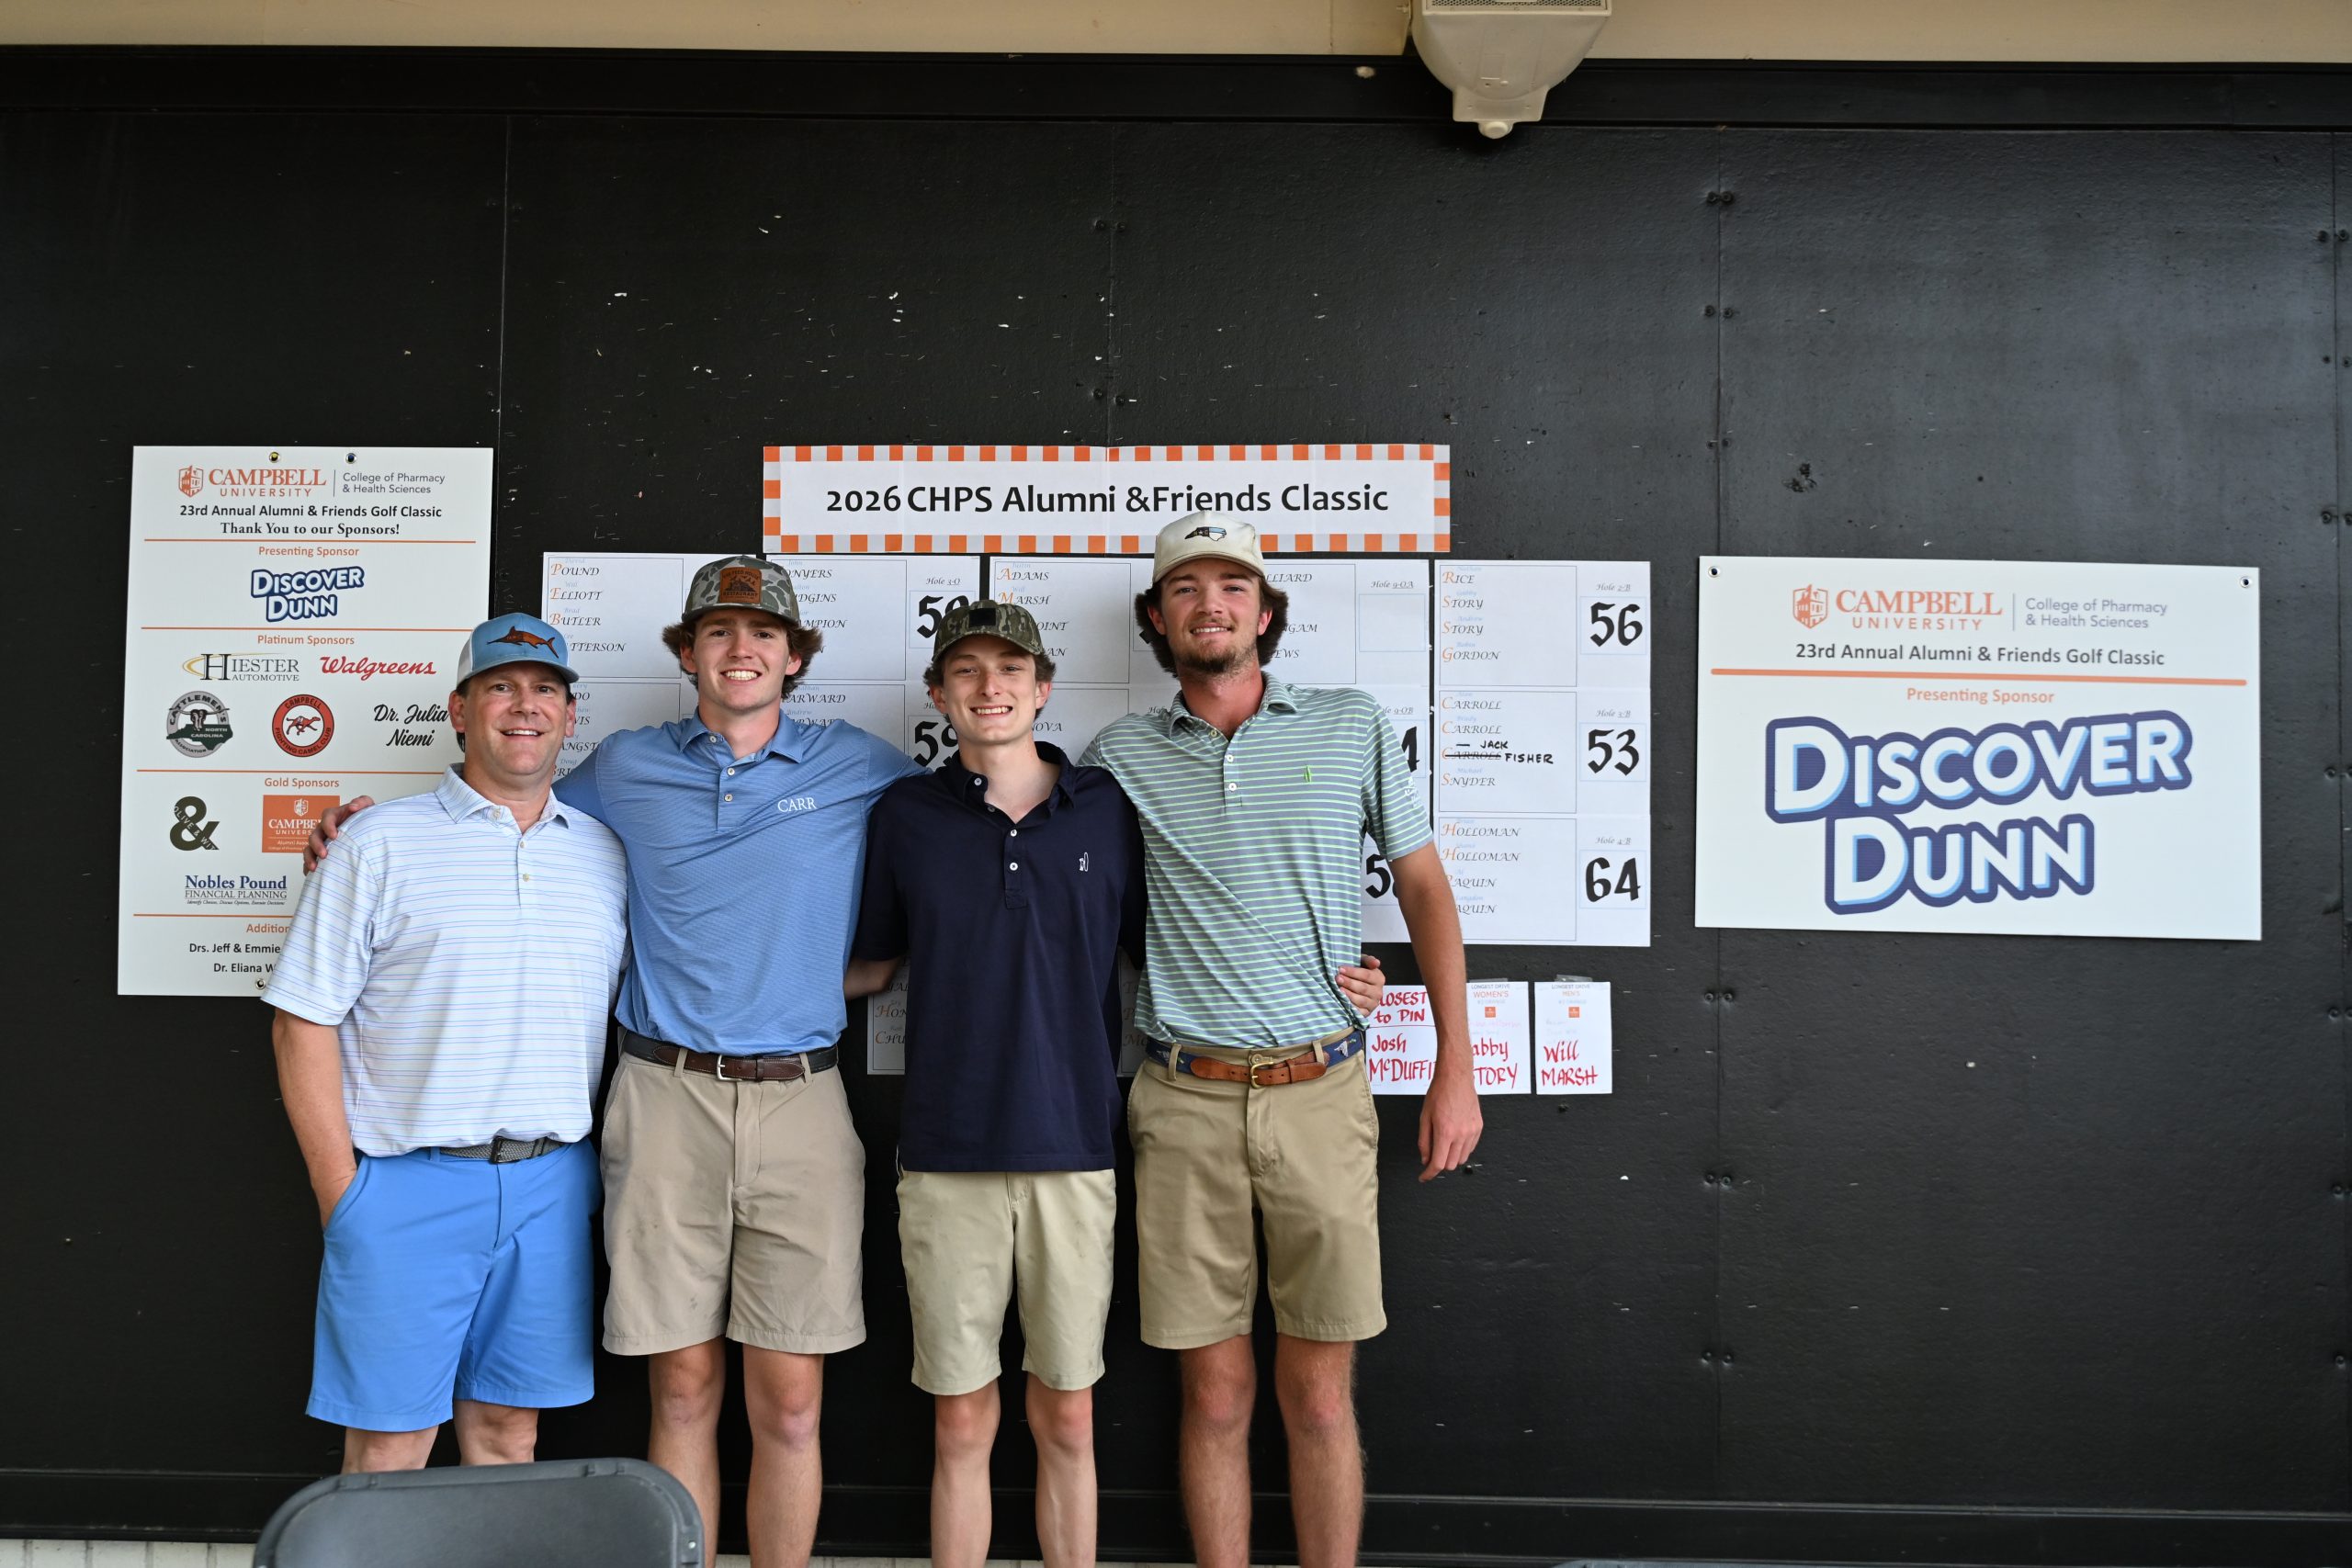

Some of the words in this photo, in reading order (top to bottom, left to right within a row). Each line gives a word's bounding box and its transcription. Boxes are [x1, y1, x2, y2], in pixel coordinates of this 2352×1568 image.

[209, 468, 327, 487] CAMPBELL
[343, 472, 381, 483] College
[384, 472, 395, 482] of
[397, 473, 446, 485] Pharmacy
[220, 488, 312, 497] UNIVERSITY
[343, 484, 352, 494] &
[354, 484, 394, 493] Health
[396, 484, 432, 494] Sciences
[827, 484, 901, 512] 2026
[907, 486, 992, 513] CHPS
[1001, 484, 1115, 513] Alumni
[1281, 483, 1388, 512] Classic
[179, 504, 209, 516] 23rd
[211, 505, 255, 516] Annual
[259, 505, 304, 517] Alumni
[308, 505, 318, 517] &
[322, 505, 368, 517] Friends
[370, 505, 398, 517] Golf
[401, 506, 442, 517] Classic
[220, 522, 262, 535] Thank
[266, 523, 290, 535] You
[294, 525, 307, 535] to
[311, 525, 334, 535] our
[337, 524, 401, 538] Sponsors!
[258, 546, 314, 557] Presenting
[316, 547, 360, 558] Sponsor
[550, 563, 600, 576] POUND
[786, 569, 832, 579] ONYERS
[997, 567, 1050, 581] ADAMS
[252, 567, 365, 597] DISCOVER
[926, 577, 945, 586] Hole
[1266, 573, 1313, 582] LLIARD
[1442, 571, 1476, 584] RICE
[1370, 581, 1391, 589] Hole
[1596, 582, 1615, 591] Hole
[549, 587, 605, 600] ELLIOTT
[795, 594, 837, 604] DGINS
[997, 592, 1052, 604] MARSH
[267, 594, 337, 621] DUNN
[1442, 595, 1484, 610] STORY
[1836, 589, 2003, 615] CAMPBELL
[2025, 597, 2078, 614] College
[2083, 598, 2098, 612] of
[2101, 599, 2168, 616] Pharmacy
[549, 613, 602, 626] BUTLER
[1589, 601, 1643, 647] 56
[1852, 616, 1983, 631] UNIVERSITY
[2025, 614, 2037, 626] &
[2041, 614, 2086, 626] Health
[2090, 615, 2149, 629] Sciences
[1038, 622, 1069, 632] OINT
[1442, 621, 1484, 636] STORY
[256, 635, 305, 646] Platinum
[307, 636, 355, 647] Sponsors
[569, 642, 628, 652] TTERSON
[1442, 646, 1501, 662] GORDON
[1795, 643, 1836, 659] 23rd
[1840, 644, 1903, 660] Annual
[1908, 645, 1973, 660] Alumni
[1977, 647, 1992, 661] &
[1996, 648, 2062, 663] Friends
[2066, 648, 2103, 665] Golf
[2107, 649, 2165, 666] Classic
[200, 653, 300, 681] HIESTER
[320, 656, 436, 681] Walgreens
[232, 673, 300, 682] AUTOMOTIVE
[284, 696, 322, 709] CAMPBELL
[784, 694, 845, 704] ARWARD
[1441, 696, 1502, 710] CARROLL
[1906, 687, 1988, 705] Presenting
[1992, 688, 2055, 706] Sponsor
[374, 704, 399, 722] Dr.
[403, 704, 448, 725] Julia
[1596, 709, 1615, 717] Hole
[1441, 720, 1502, 734] CARROLL
[275, 727, 298, 753] FIGHTING
[298, 745, 322, 755] CAMEL
[319, 727, 332, 747] CLUB
[386, 729, 435, 747] Niemi
[1480, 740, 1509, 750] JACK
[1401, 726, 1420, 773] 4
[1588, 728, 1639, 776] 53
[1505, 752, 1554, 764] FISHER
[1769, 713, 2190, 818] DISCOVER
[265, 777, 288, 787] Gold
[291, 778, 340, 789] Sponsors
[1441, 773, 1496, 787] SNYDER
[777, 796, 818, 812] CARR
[174, 805, 195, 830] OLIVE
[268, 818, 322, 829] CAMPBE
[1441, 822, 1521, 837] HOLLOMAN
[1596, 836, 1615, 844] Hole
[1440, 846, 1521, 862] HOLLOMAN
[1828, 814, 2091, 910] DUNN
[185, 874, 235, 888] Nobles
[240, 875, 287, 889] Pound
[1364, 853, 1398, 898] 5
[1585, 856, 1641, 903] 64
[185, 890, 235, 898] FINANCIAL
[237, 890, 288, 899] PLANNING
[1456, 904, 1498, 915] AQUIN
[189, 943, 209, 953] Drs.
[212, 943, 231, 953] Jeff
[233, 943, 243, 953] &
[245, 944, 281, 953] Emmie
[213, 963, 228, 972] Dr.
[232, 964, 262, 973] Eliana
[1378, 990, 1428, 1007] LOSEST
[1473, 990, 1510, 998] WOMEN'S
[1374, 1010, 1392, 1023] to
[1398, 1009, 1426, 1023] PIN
[1372, 1032, 1407, 1054] Josh
[1472, 1037, 1510, 1063] abby
[1543, 1040, 1579, 1063] Will
[1369, 1059, 1437, 1083] McDUFFI
[1473, 1062, 1518, 1089] TORY
[1541, 1065, 1599, 1088] MARSH
